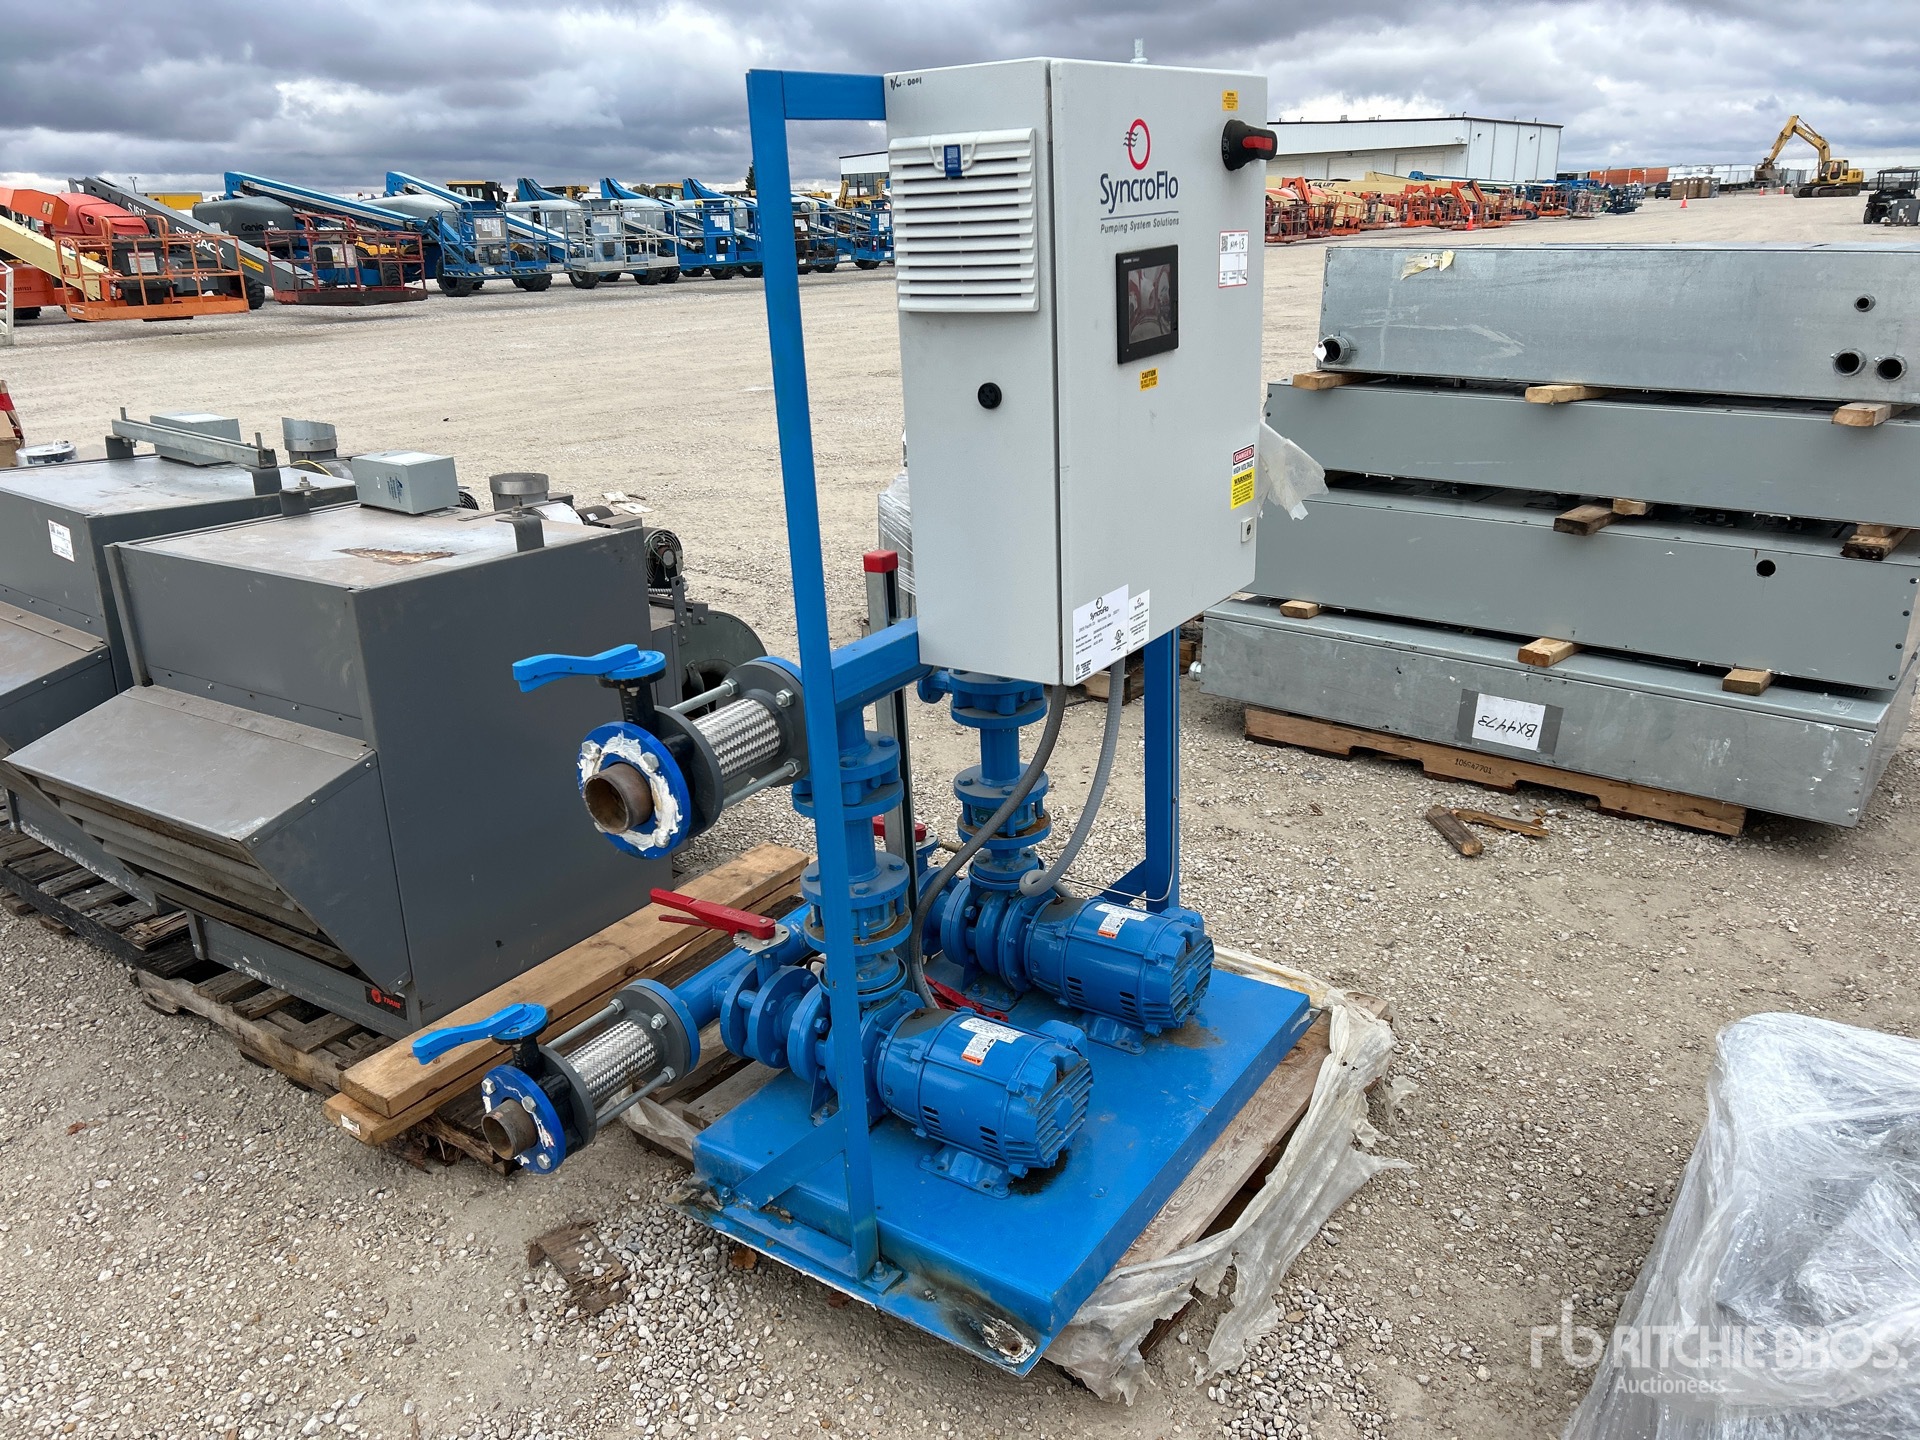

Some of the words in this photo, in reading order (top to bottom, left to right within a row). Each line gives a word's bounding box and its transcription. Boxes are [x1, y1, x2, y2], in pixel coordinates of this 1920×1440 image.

[1100, 170, 1179, 214] SyncroFlo
[240, 222, 265, 232] Genie
[1100, 221, 1128, 235] Pumping
[1129, 218, 1151, 231] System
[1153, 216, 1180, 229] Solutions
[1235, 448, 1252, 462] DANGER
[1241, 460, 1254, 471] VOLTAGE
[1233, 472, 1253, 485] WARNING
[1477, 715, 1538, 739] BX4473
[383, 996, 401, 1009] TRANE
